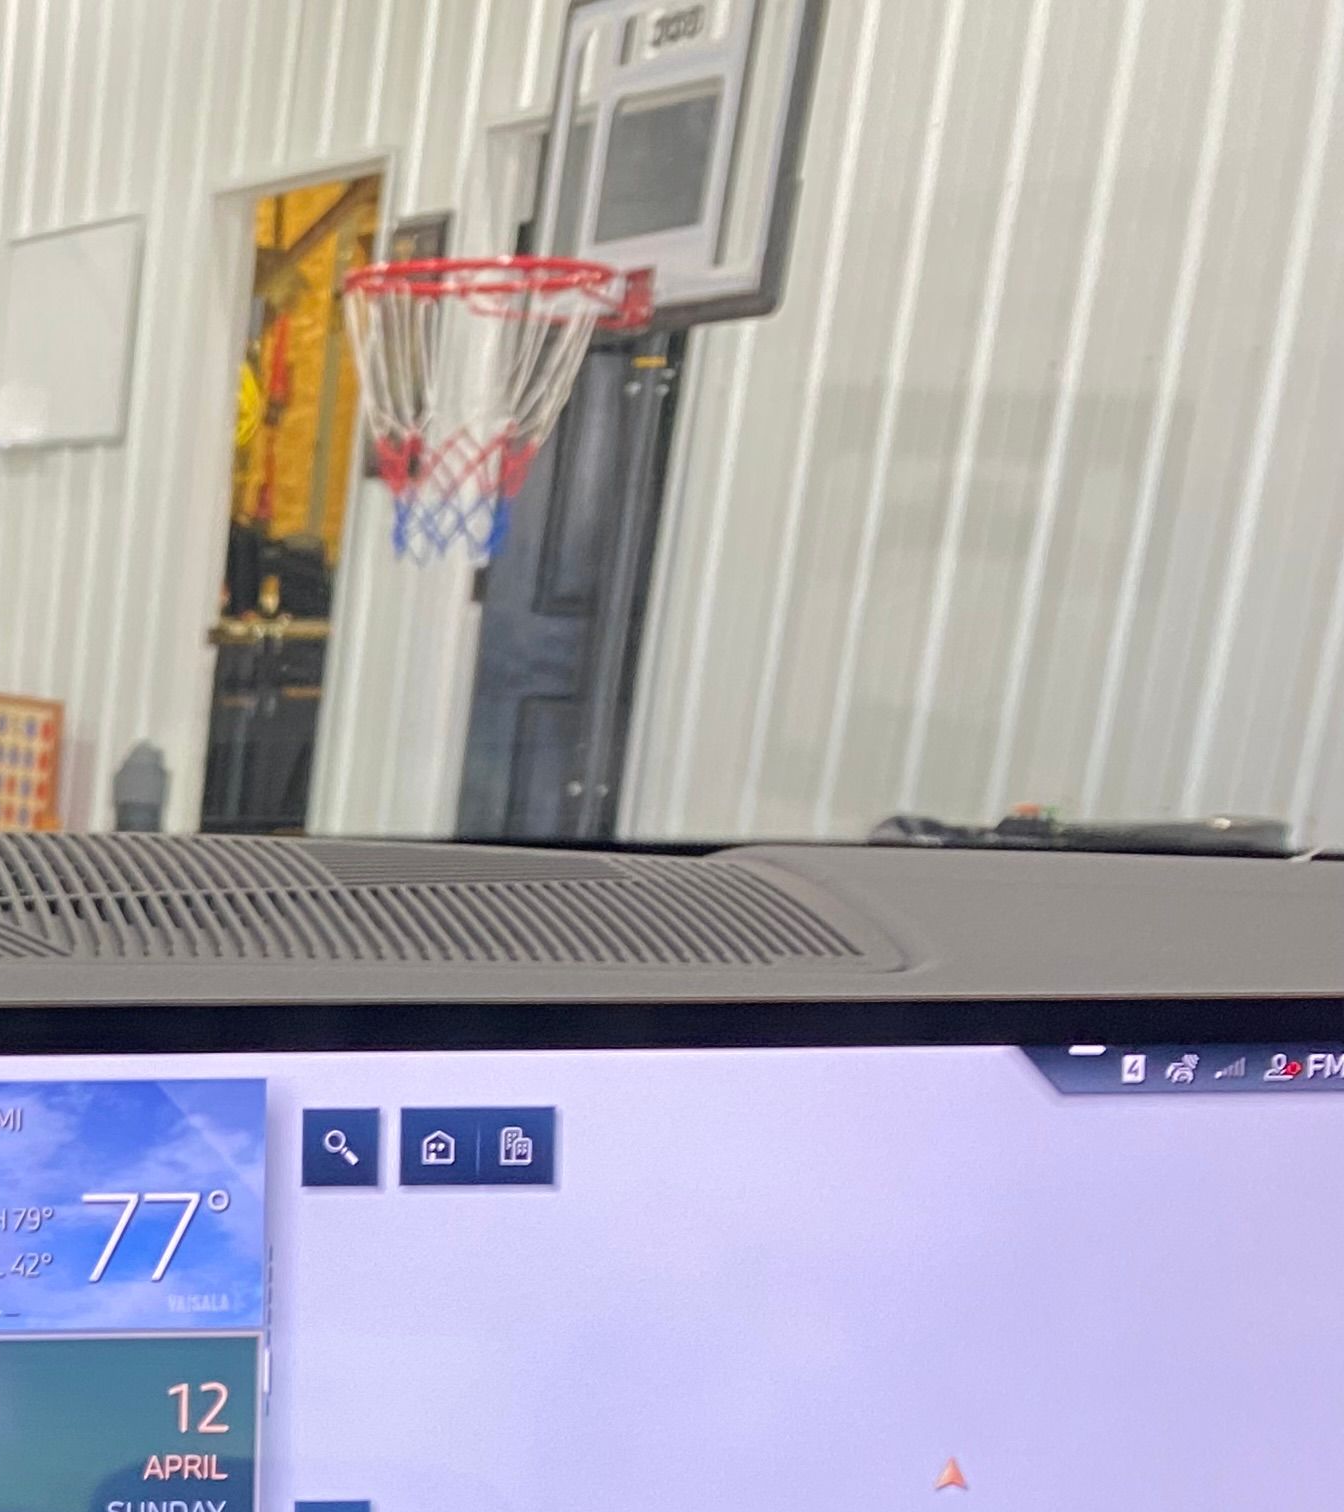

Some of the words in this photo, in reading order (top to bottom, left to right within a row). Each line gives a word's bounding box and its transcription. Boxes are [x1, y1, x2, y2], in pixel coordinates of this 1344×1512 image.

[12, 1206, 55, 1232] 79°
[82, 1189, 231, 1283] 77°
[11, 1252, 53, 1277] 42°
[167, 1381, 231, 1434] 12
[143, 1453, 229, 1481] APRIL
